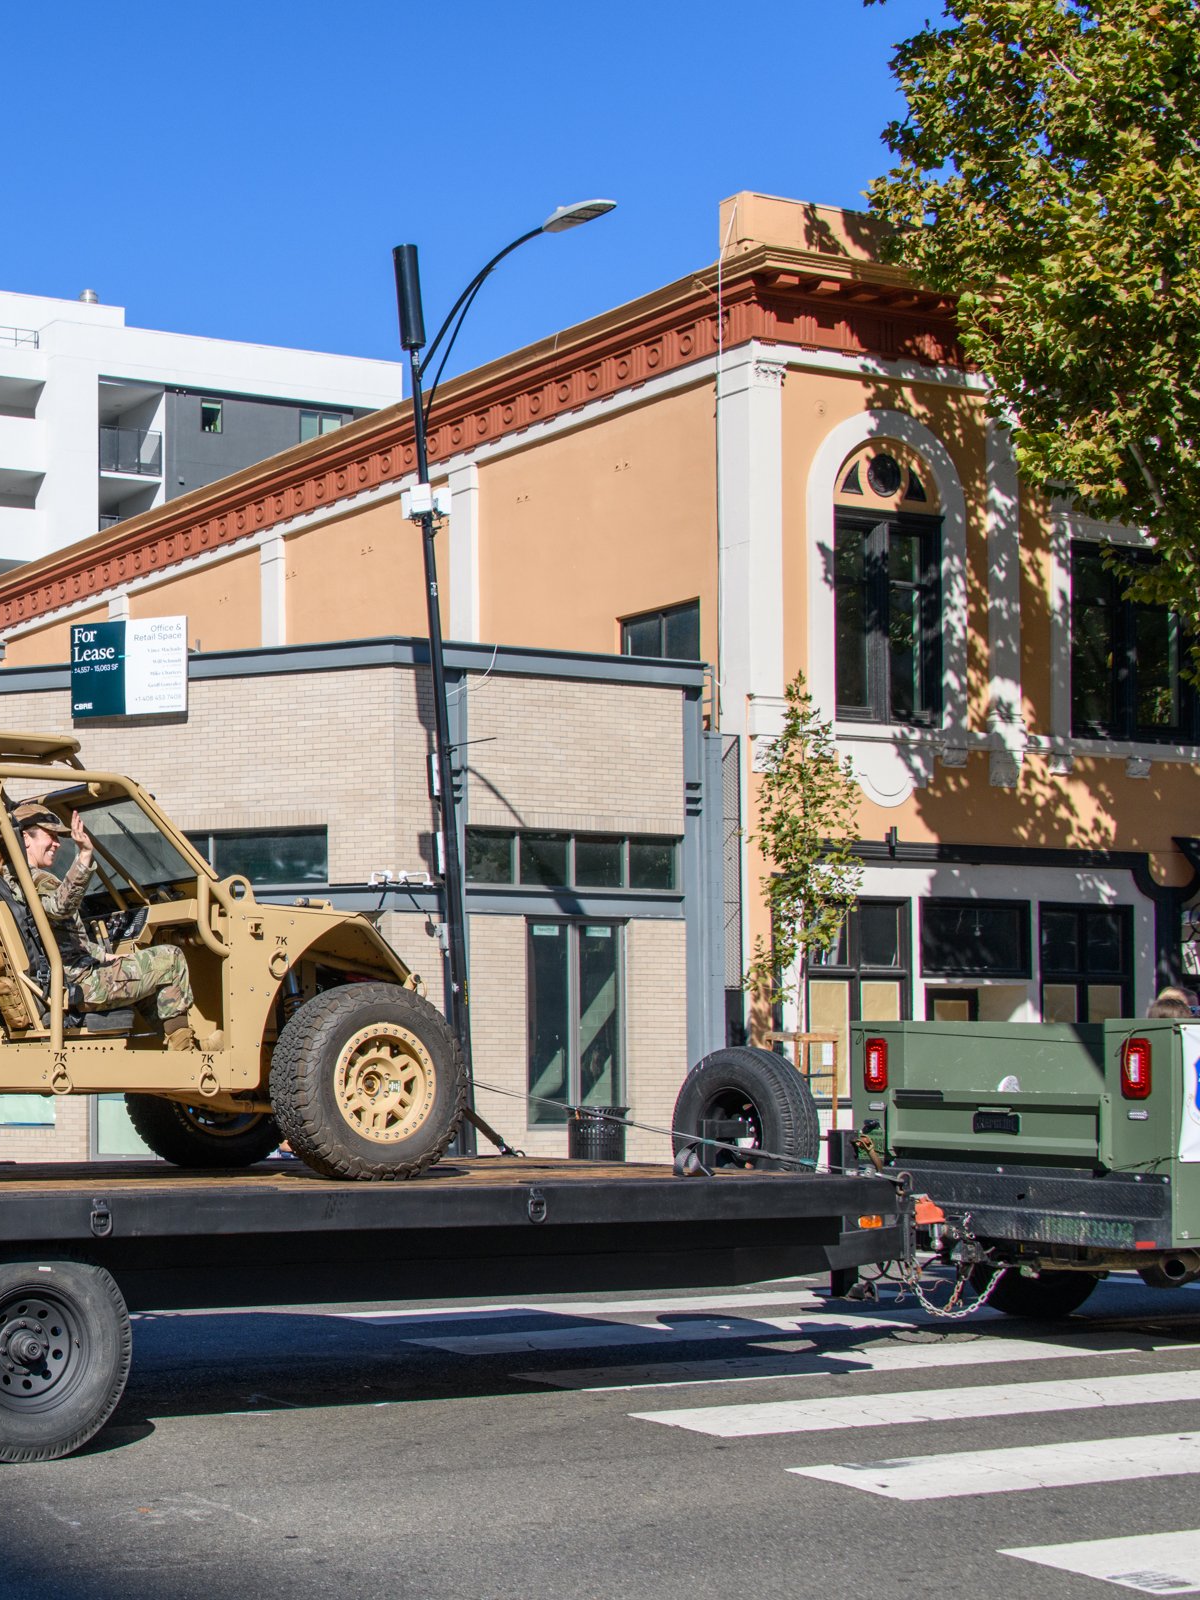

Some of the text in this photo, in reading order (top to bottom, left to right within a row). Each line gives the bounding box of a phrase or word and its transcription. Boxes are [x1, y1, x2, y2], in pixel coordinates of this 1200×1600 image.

[150, 623, 182, 633] Office &
[74, 628, 97, 644] For
[157, 632, 182, 640] Space
[73, 647, 115, 663] Lease
[111, 663, 119, 671] SF
[74, 702, 93, 710] CBRE
[275, 936, 288, 946] 7K
[54, 1052, 67, 1062] 7K
[201, 1054, 214, 1064] 7K
